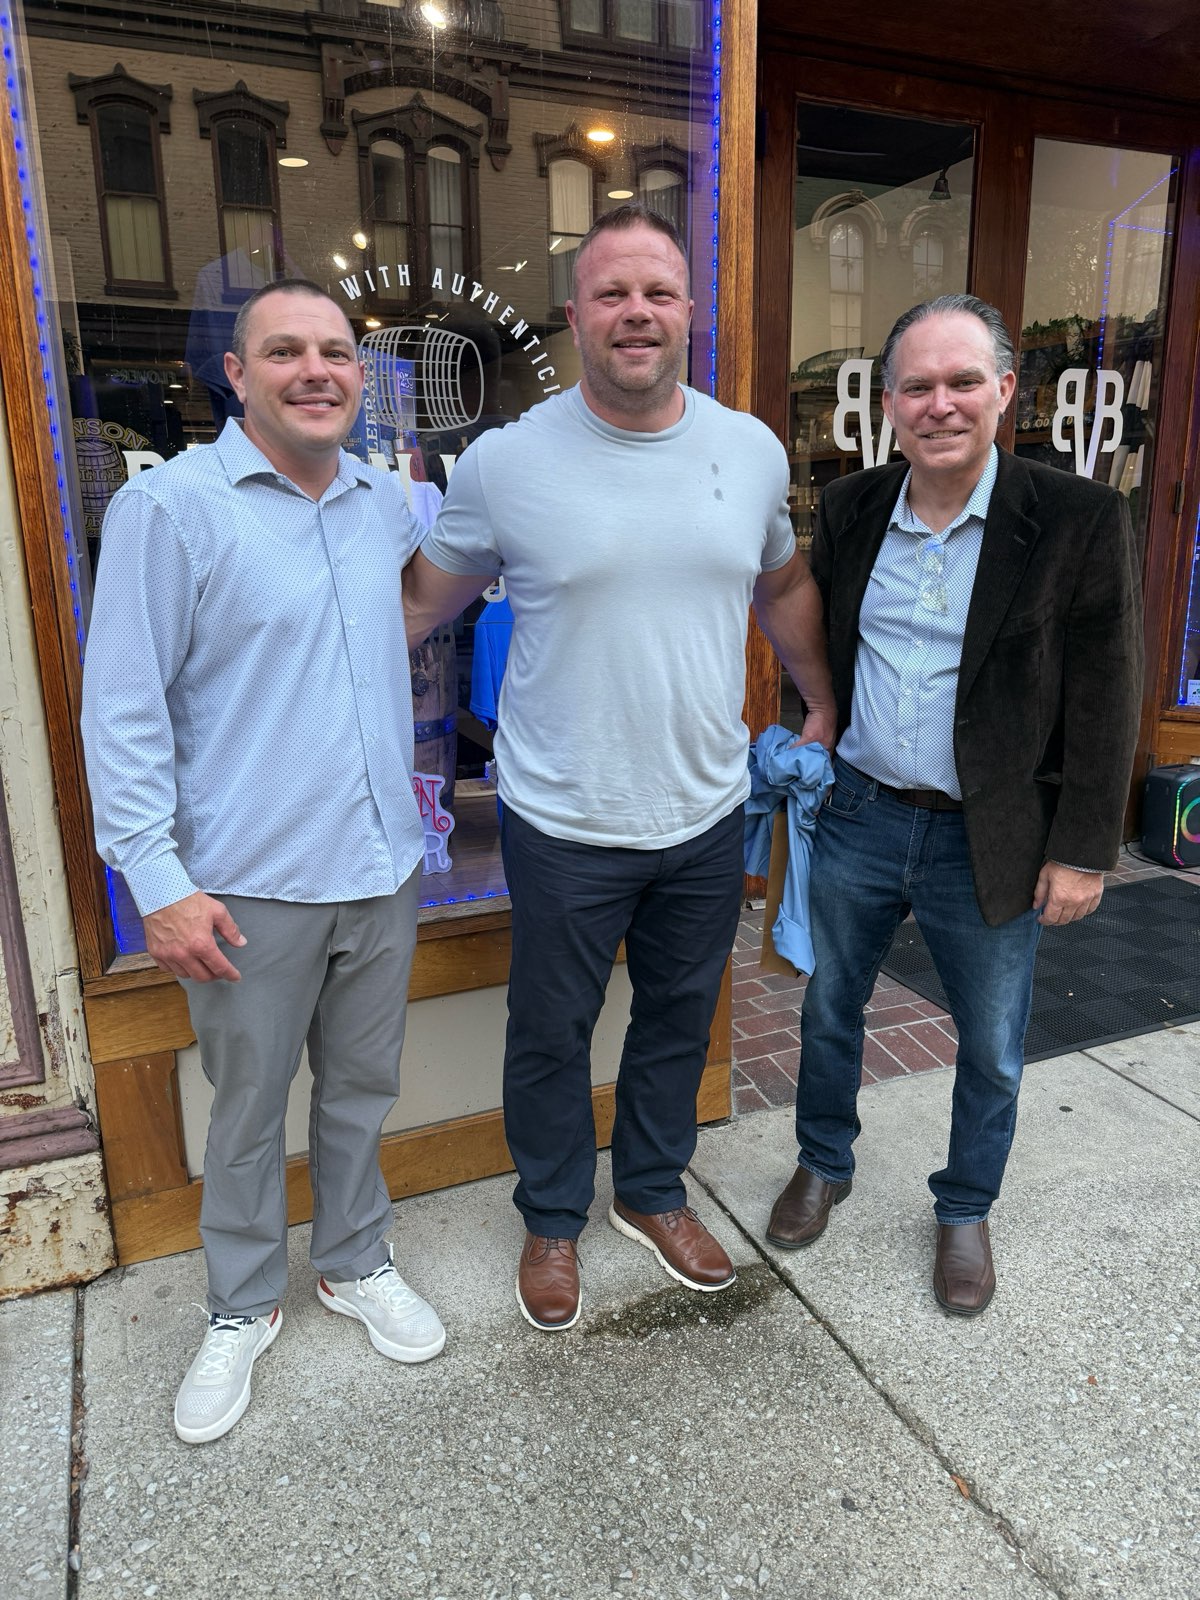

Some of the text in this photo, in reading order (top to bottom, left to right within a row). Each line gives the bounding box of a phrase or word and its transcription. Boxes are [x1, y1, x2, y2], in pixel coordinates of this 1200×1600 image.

[339, 264, 561, 394] WITH AUTHENTICI
[73, 418, 150, 451] NSON
[79, 468, 128, 482] LLE
